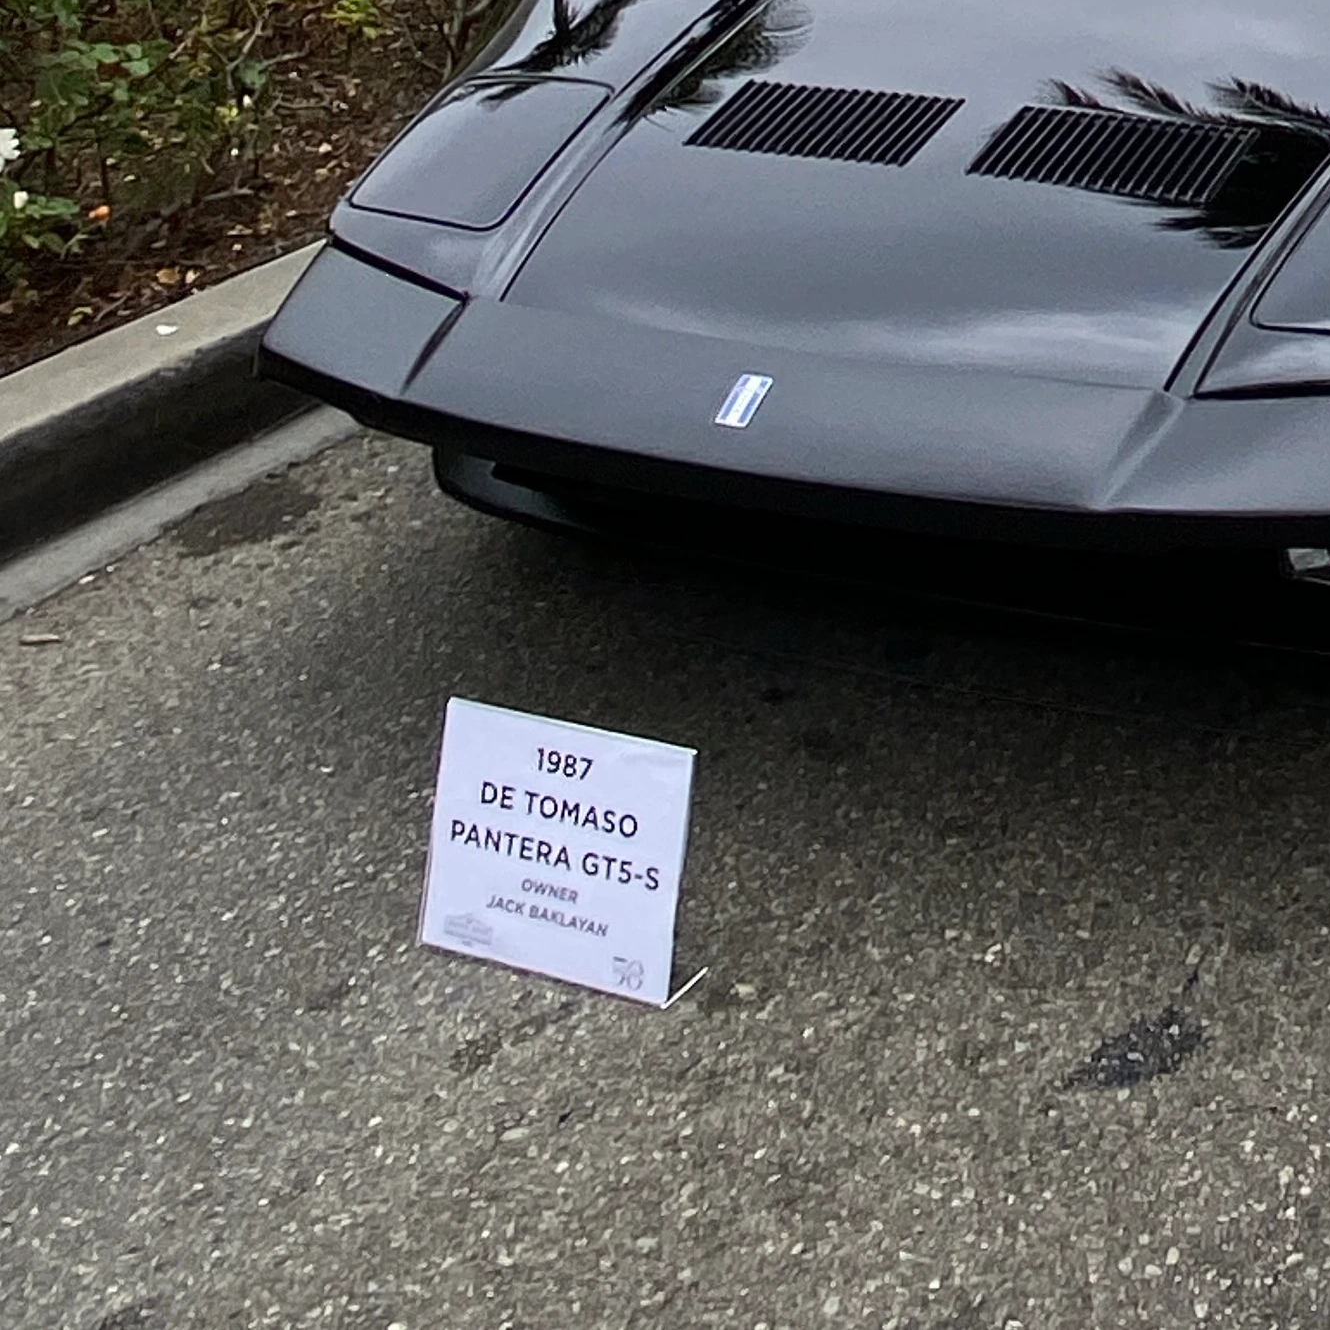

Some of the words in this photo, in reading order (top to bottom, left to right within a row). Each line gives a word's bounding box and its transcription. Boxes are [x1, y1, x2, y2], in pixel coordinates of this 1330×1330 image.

[536, 747, 594, 780] 1987
[481, 781, 516, 810] DE
[524, 790, 638, 838] TOMASO
[451, 820, 571, 871] PANTERA
[582, 852, 660, 890] GT5-S
[520, 878, 579, 904] OWNER
[486, 894, 524, 916] JACK
[529, 904, 609, 937] BAKLAYAN
